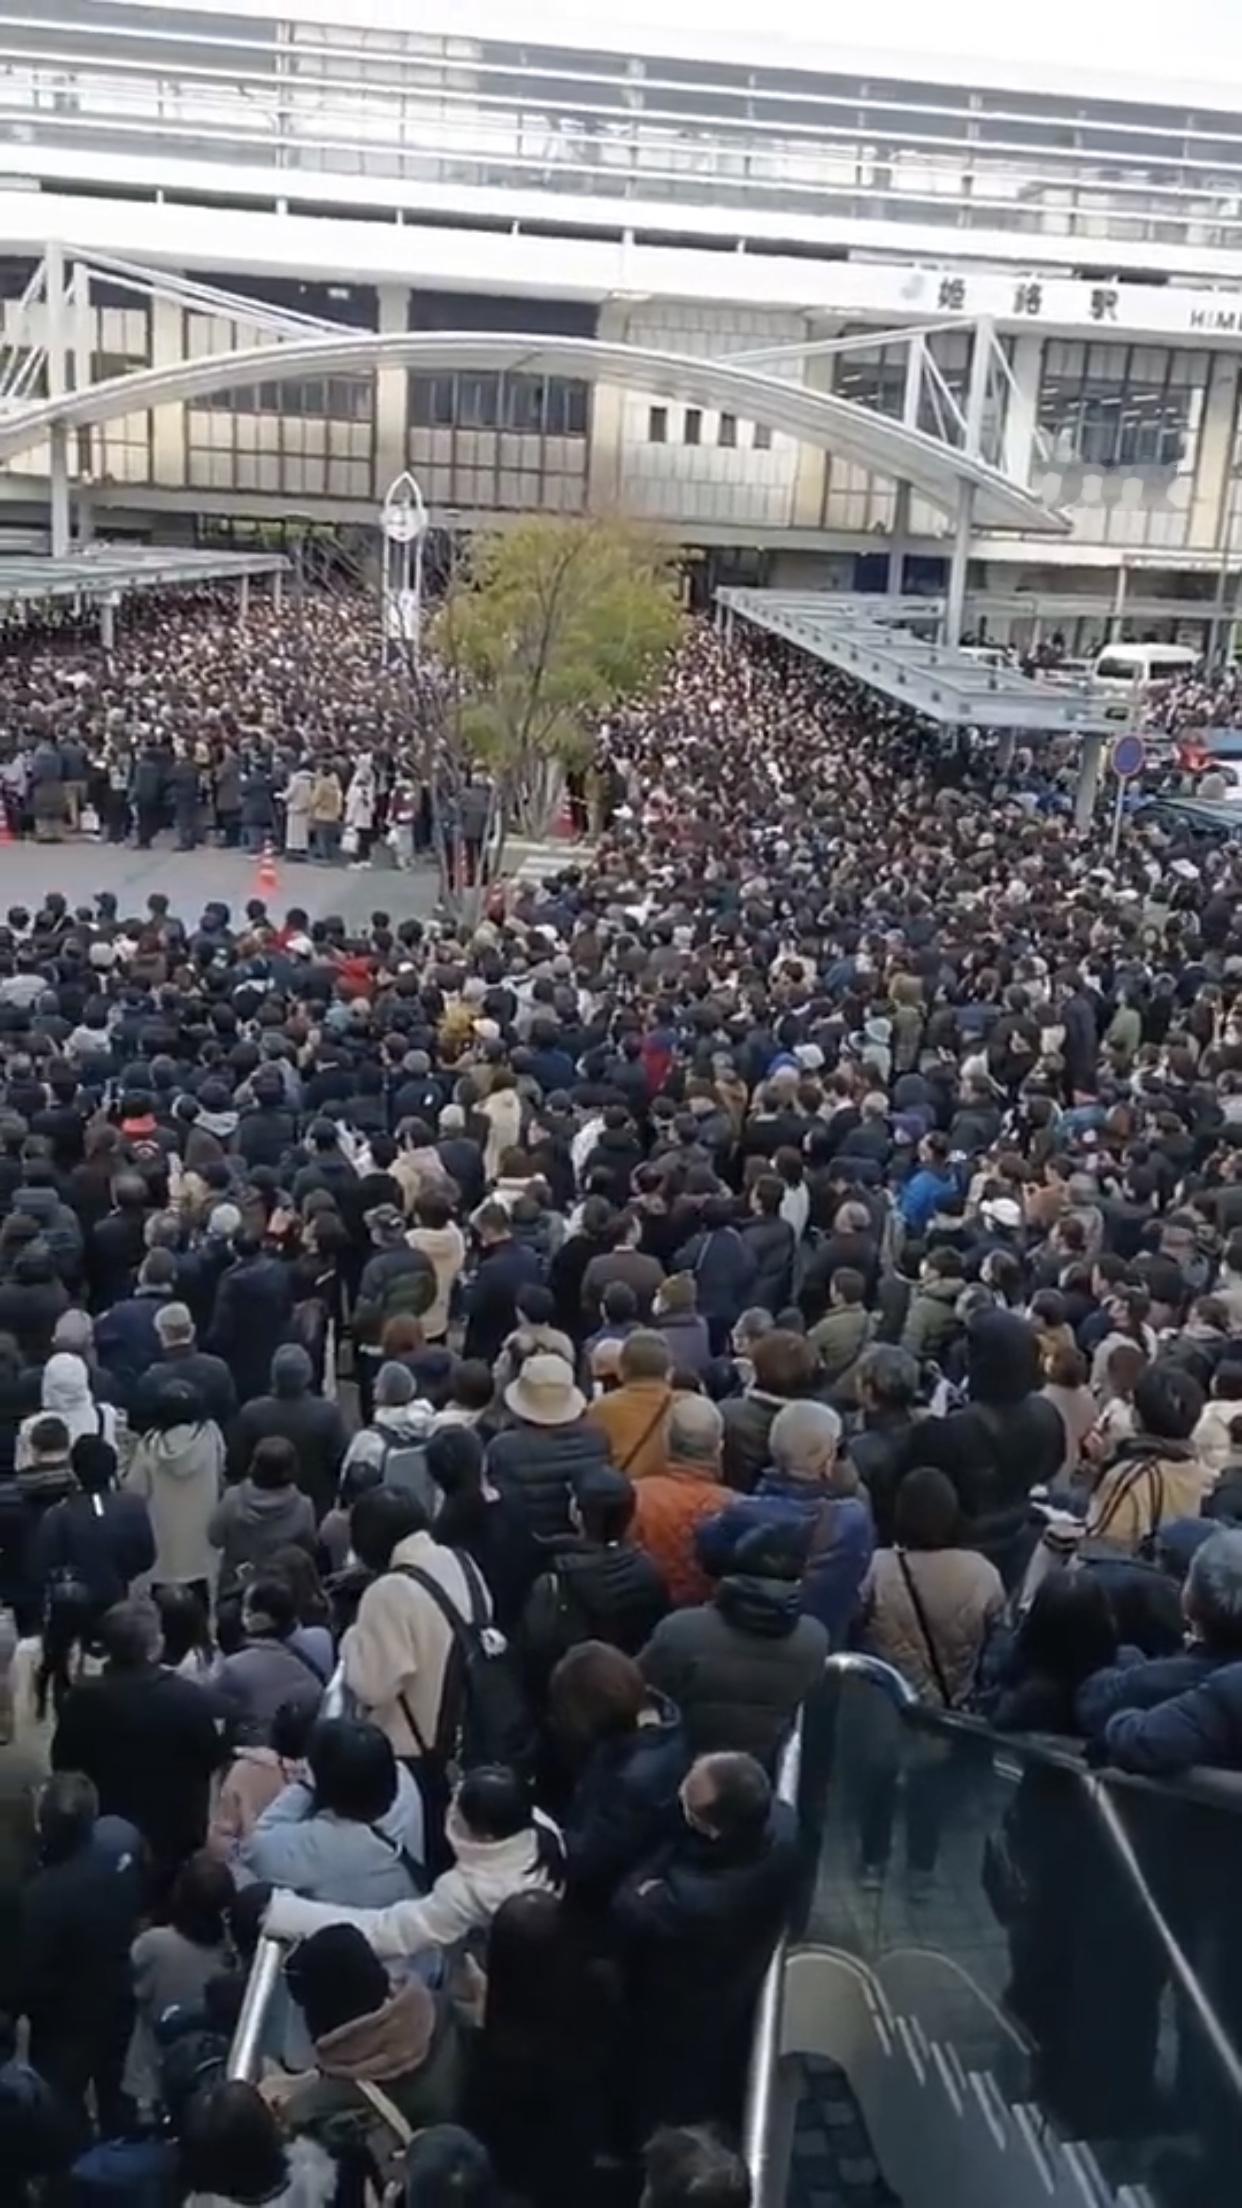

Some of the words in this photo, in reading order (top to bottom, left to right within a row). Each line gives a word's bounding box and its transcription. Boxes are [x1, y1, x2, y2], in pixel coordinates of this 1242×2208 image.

[938, 277, 1119, 321] 姫路駅
[1190, 310, 1242, 331] HIM
